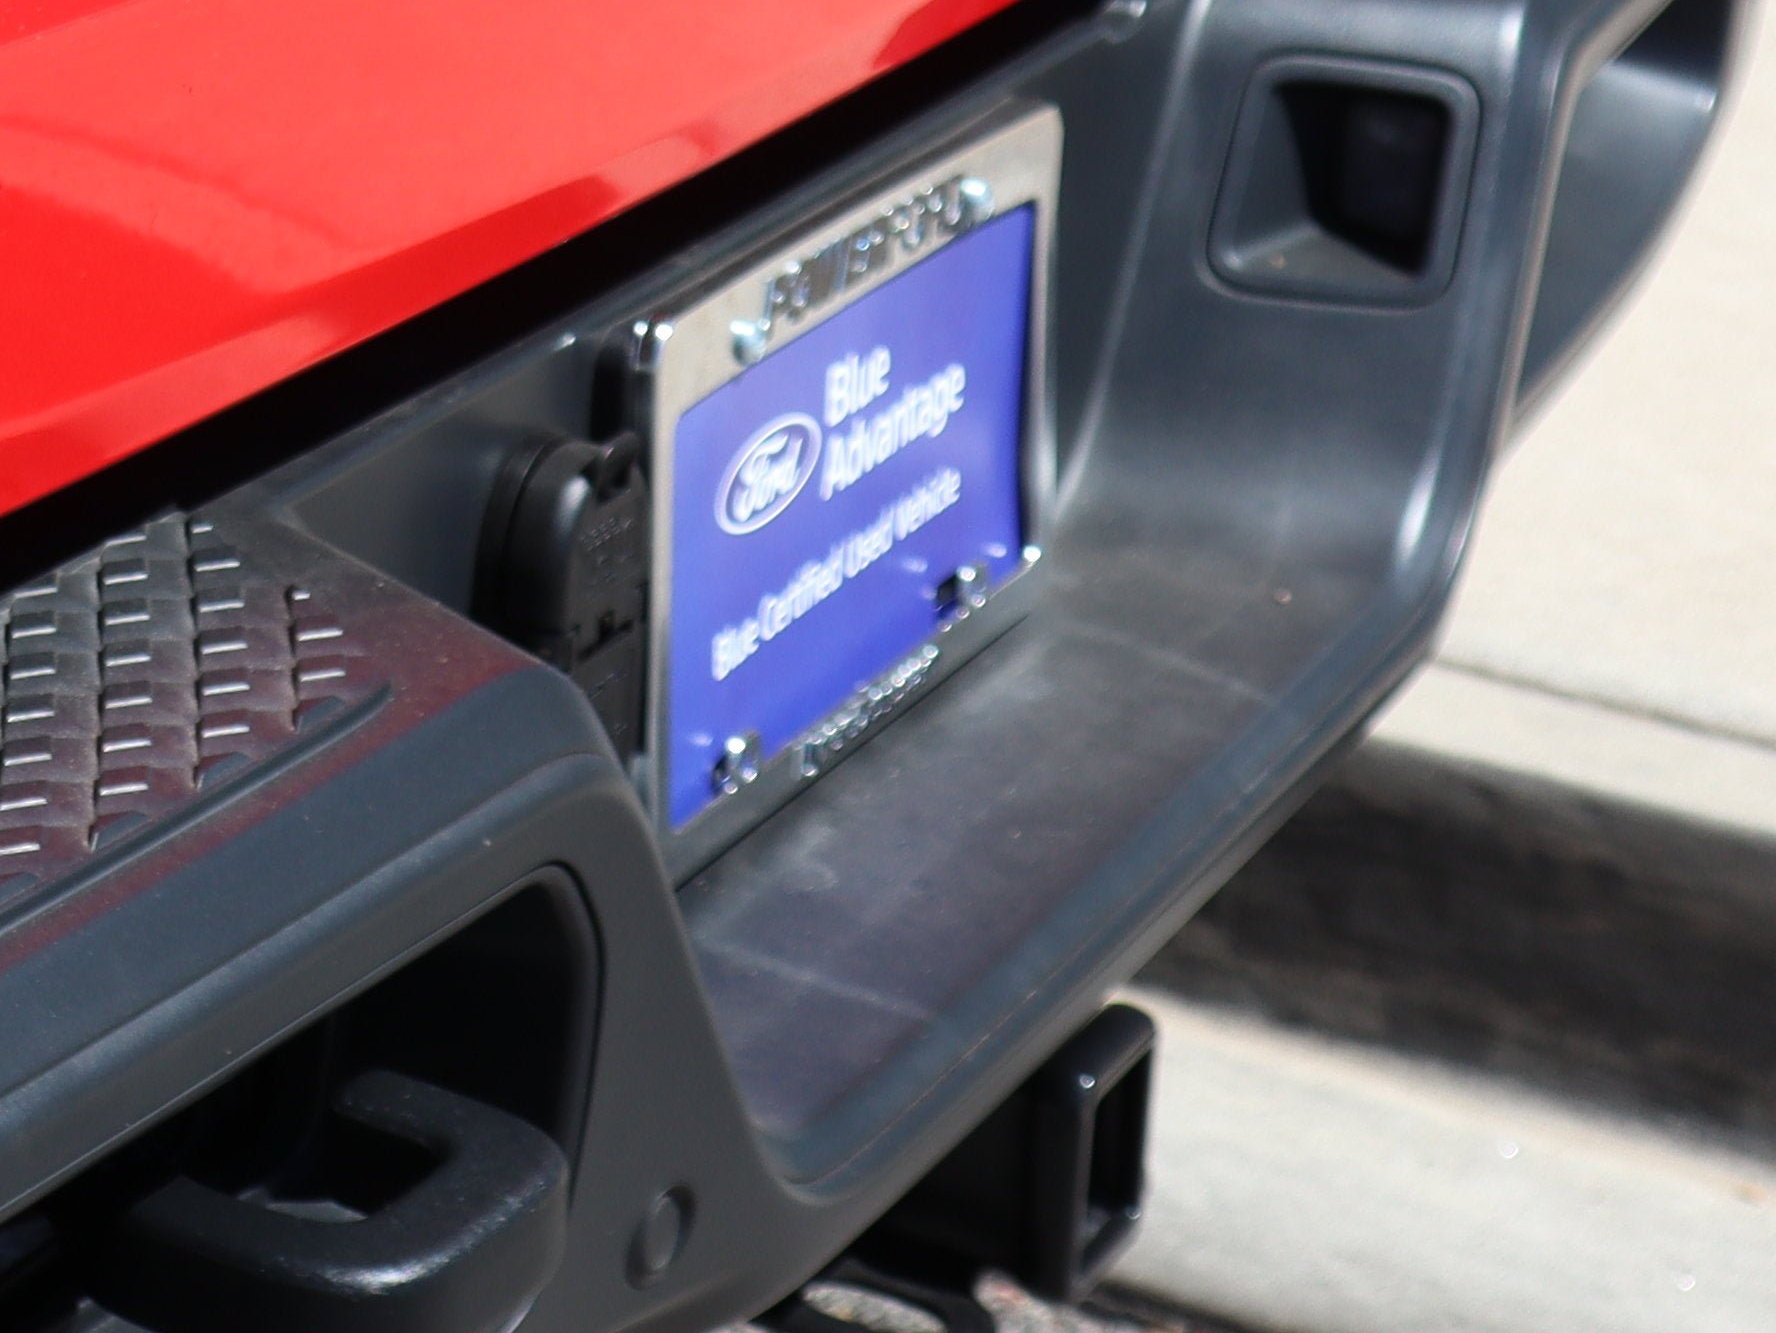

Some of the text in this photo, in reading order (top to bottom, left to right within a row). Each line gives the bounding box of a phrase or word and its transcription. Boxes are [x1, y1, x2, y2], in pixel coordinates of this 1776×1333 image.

[818, 363, 966, 502] Advantage
[823, 345, 892, 428] Blue
[731, 433, 804, 523] Ford
[710, 467, 962, 681] Blue Certified Used Vehicle
